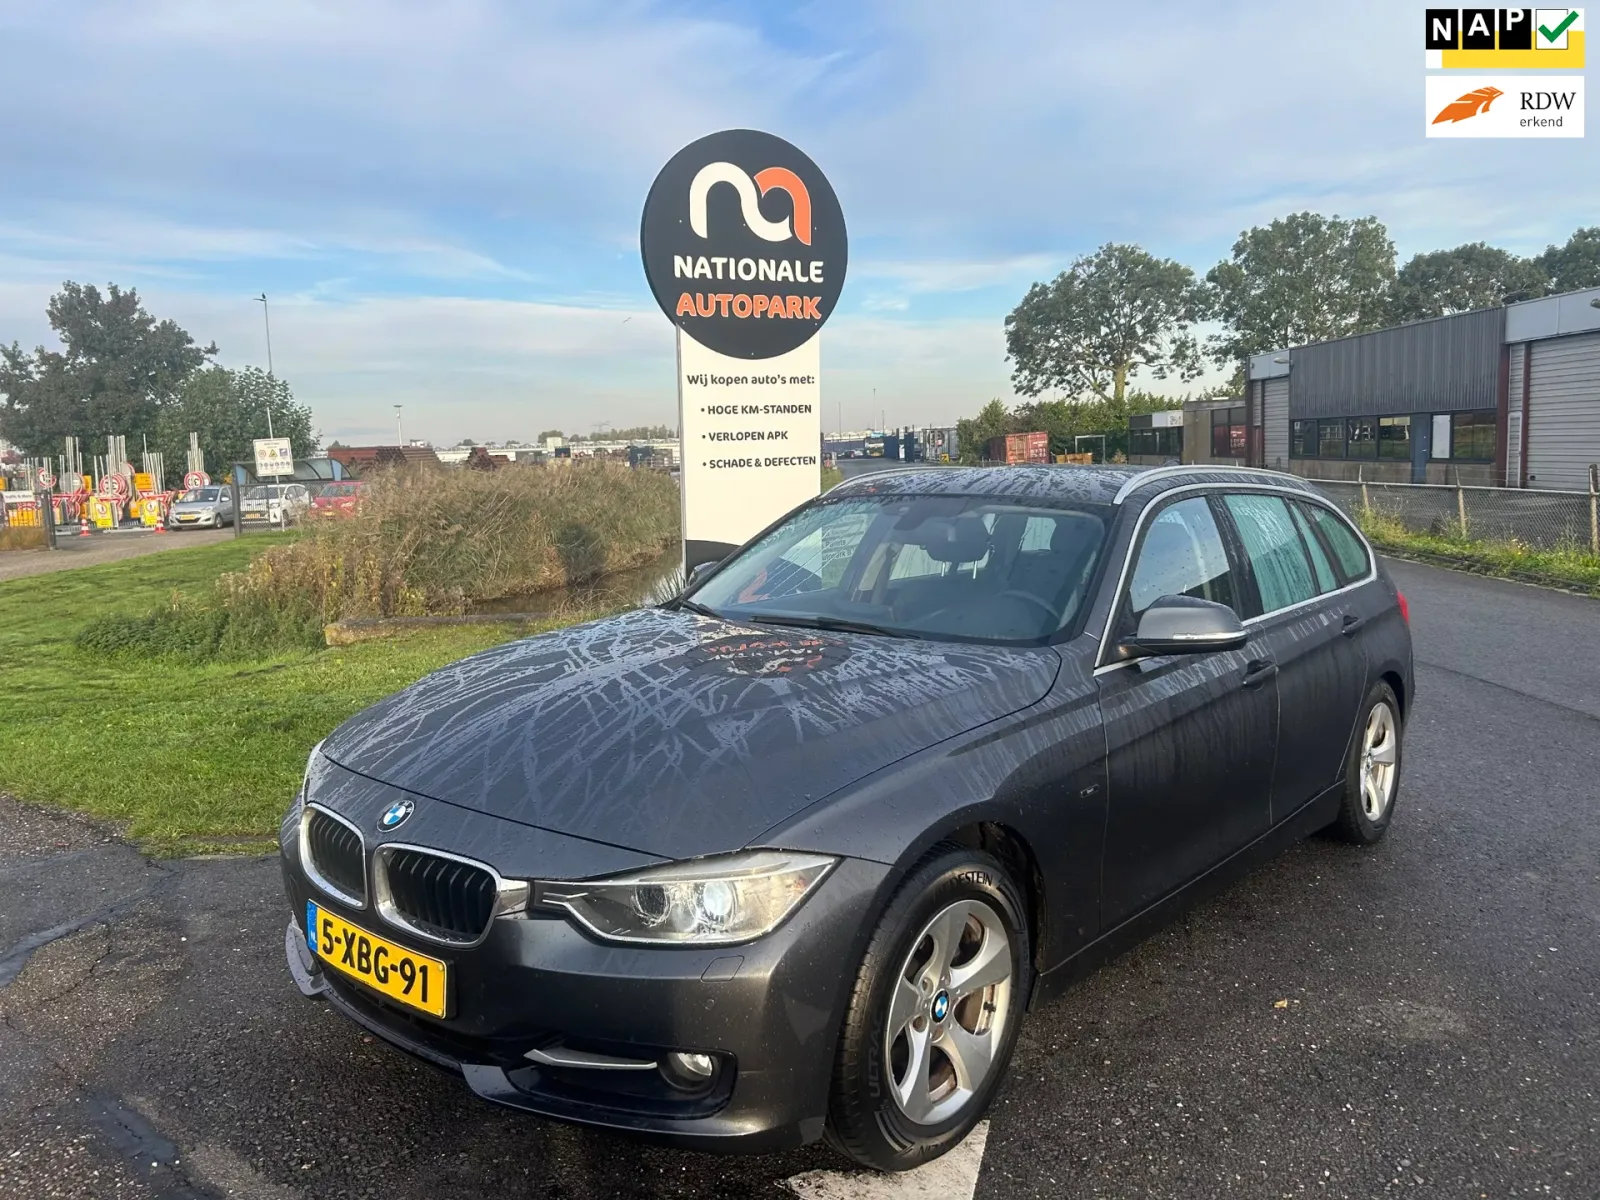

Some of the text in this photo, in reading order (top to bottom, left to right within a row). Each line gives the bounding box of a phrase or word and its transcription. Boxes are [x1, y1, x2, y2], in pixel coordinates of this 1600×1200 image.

[673, 255, 824, 283] NATIONALE
[676, 292, 822, 320] AUTOPARK
[686, 374, 815, 387] Wij kopen auto's met:
[707, 404, 812, 415] HOGE KM-STANDEN
[708, 431, 788, 441] VERLOPEN APK
[709, 456, 816, 469] SCHADE & DEFECTEN
[322, 918, 429, 1003] 5-XBG-91
